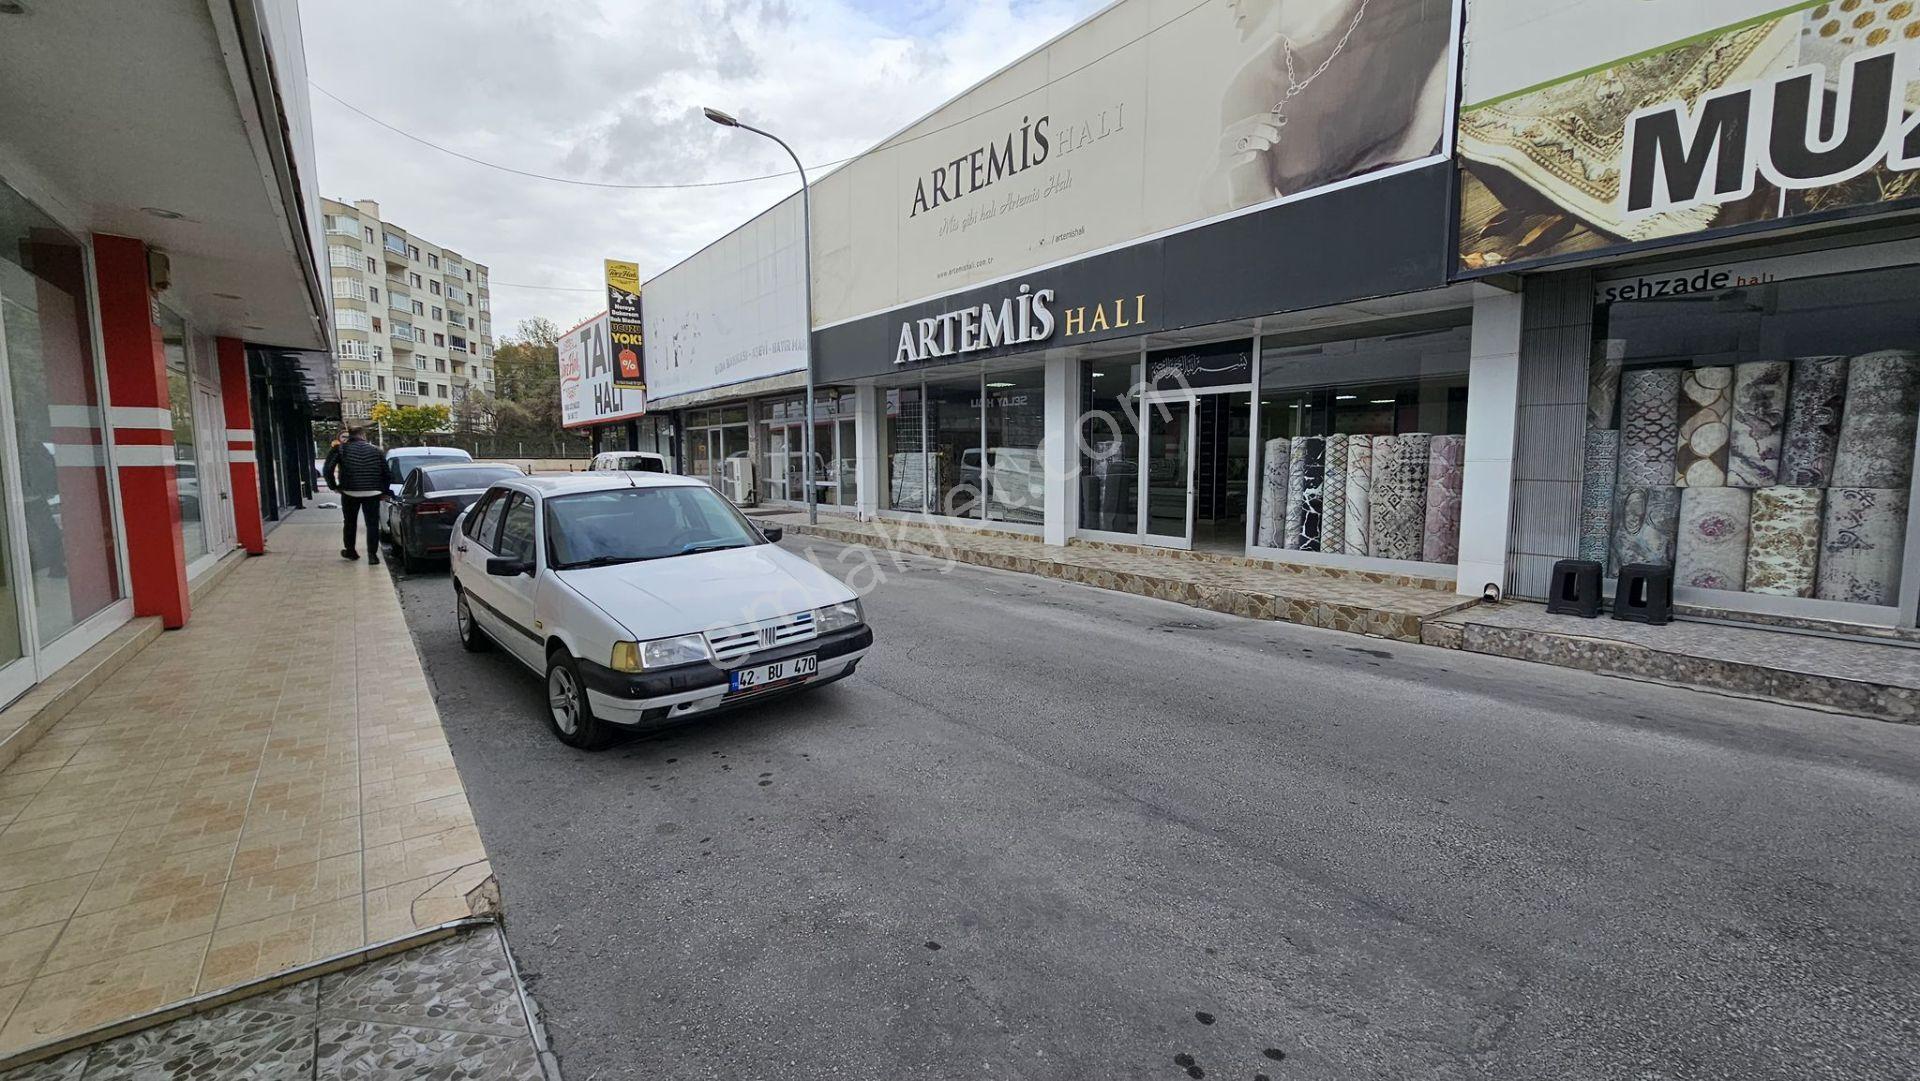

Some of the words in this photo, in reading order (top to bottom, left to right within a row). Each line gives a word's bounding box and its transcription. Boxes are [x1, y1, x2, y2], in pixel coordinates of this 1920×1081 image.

[909, 115, 1050, 218] ARTEMİS
[1056, 102, 1125, 158] HALI
[611, 332, 642, 345] YOK!
[893, 283, 1055, 364] ARTEMİS
[1065, 294, 1146, 336] HALI
[581, 318, 611, 379] TA
[594, 382, 623, 415] HALI
[740, 670, 755, 686] 42
[768, 663, 783, 681] BU
[795, 657, 815, 674] 470
